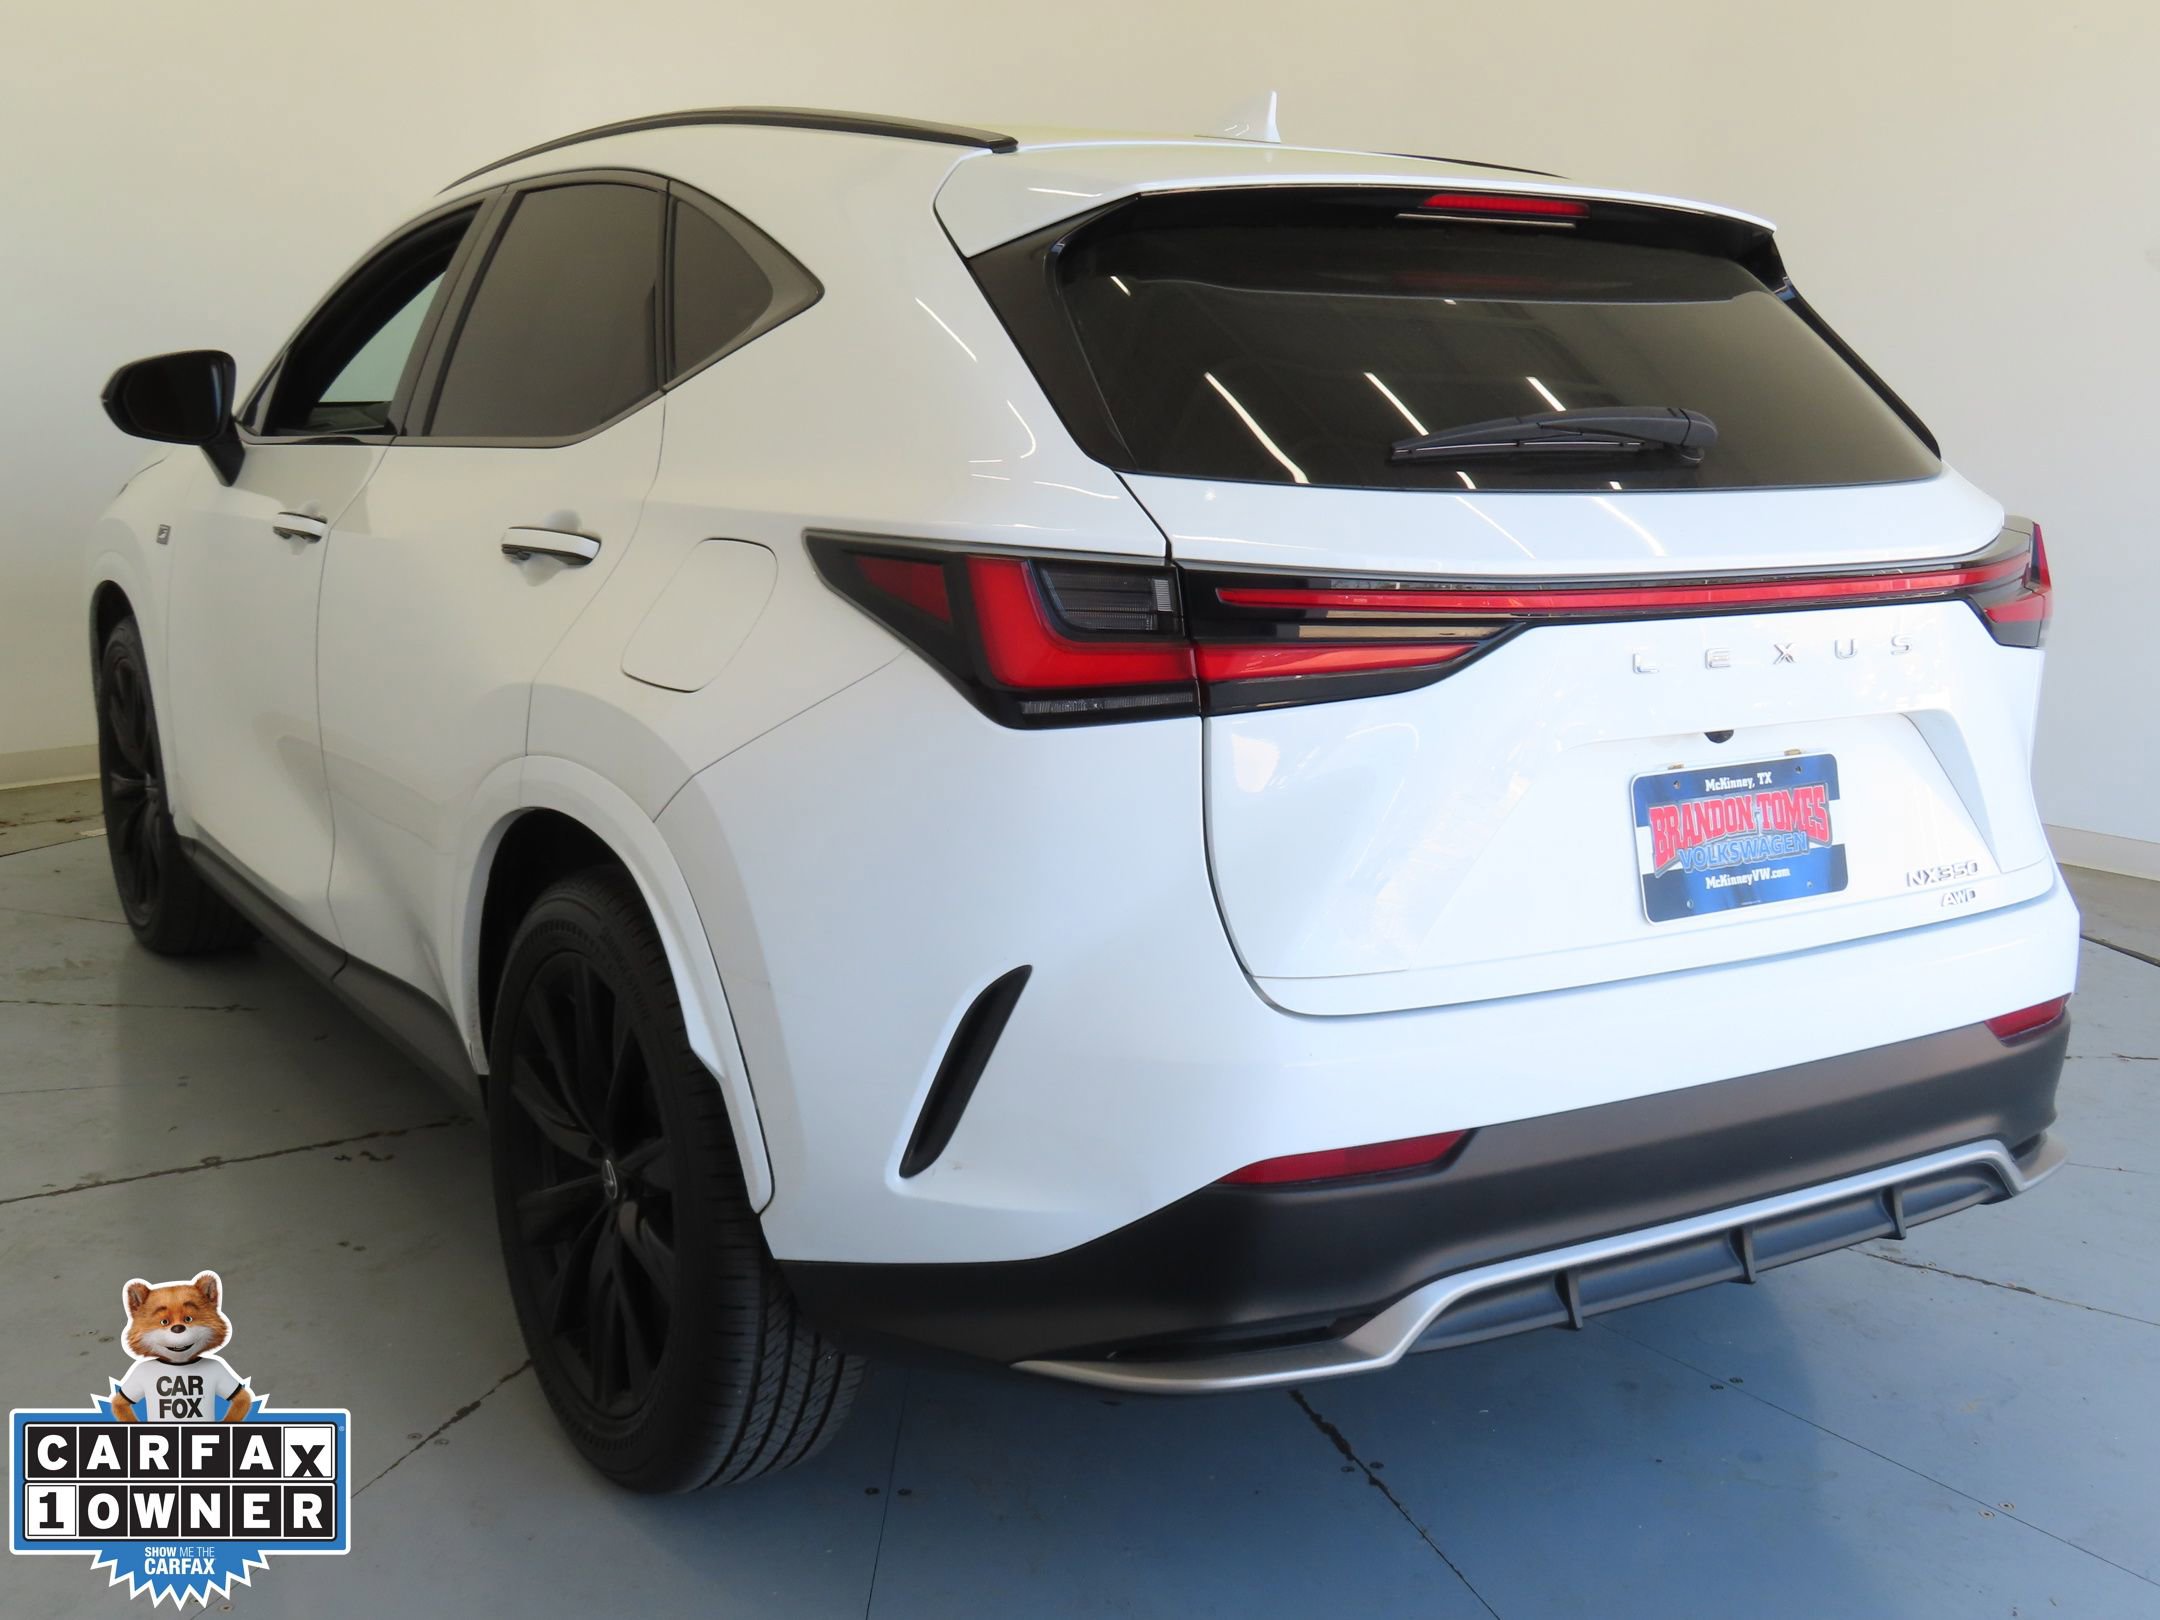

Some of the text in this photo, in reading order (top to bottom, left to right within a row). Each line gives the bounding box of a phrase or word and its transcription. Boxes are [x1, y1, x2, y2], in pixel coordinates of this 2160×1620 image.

[1632, 634, 1913, 674] LEXUS
[1705, 772, 1772, 792] McKinney, TX
[1649, 784, 1829, 869] BRANDON TOMES
[1679, 832, 1808, 872] VOLKSWAGEN
[1705, 867, 1791, 890] McKinneyVW.com
[1905, 861, 1980, 887] NX350
[1940, 889, 1977, 908] AWD
